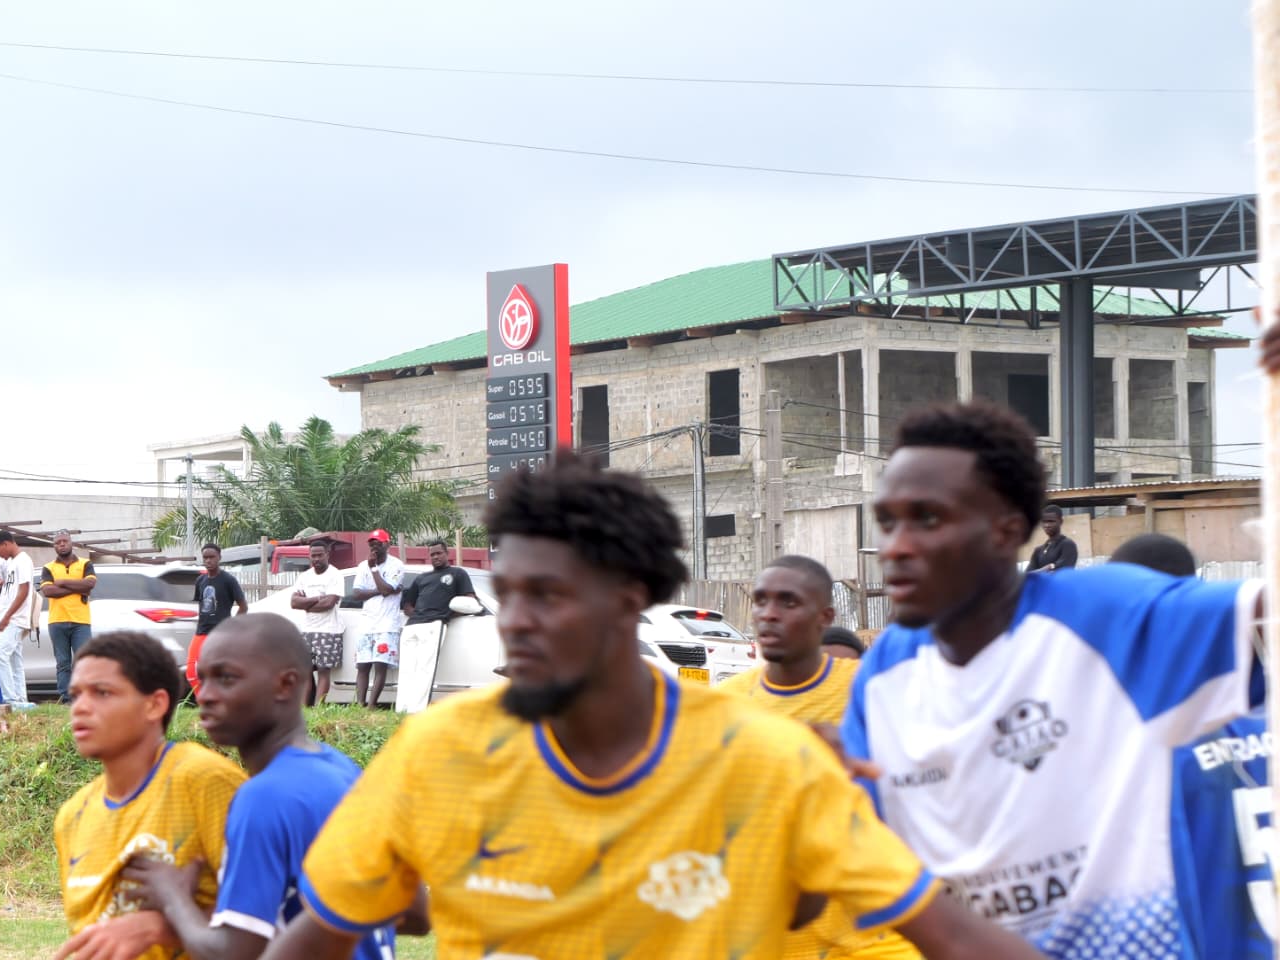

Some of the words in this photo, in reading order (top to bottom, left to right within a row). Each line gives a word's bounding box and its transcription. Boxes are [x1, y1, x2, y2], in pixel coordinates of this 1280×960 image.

[493, 353, 524, 367] GAB
[509, 377, 544, 396] 0595
[510, 404, 544, 422] 0575
[511, 431, 545, 449] 0450
